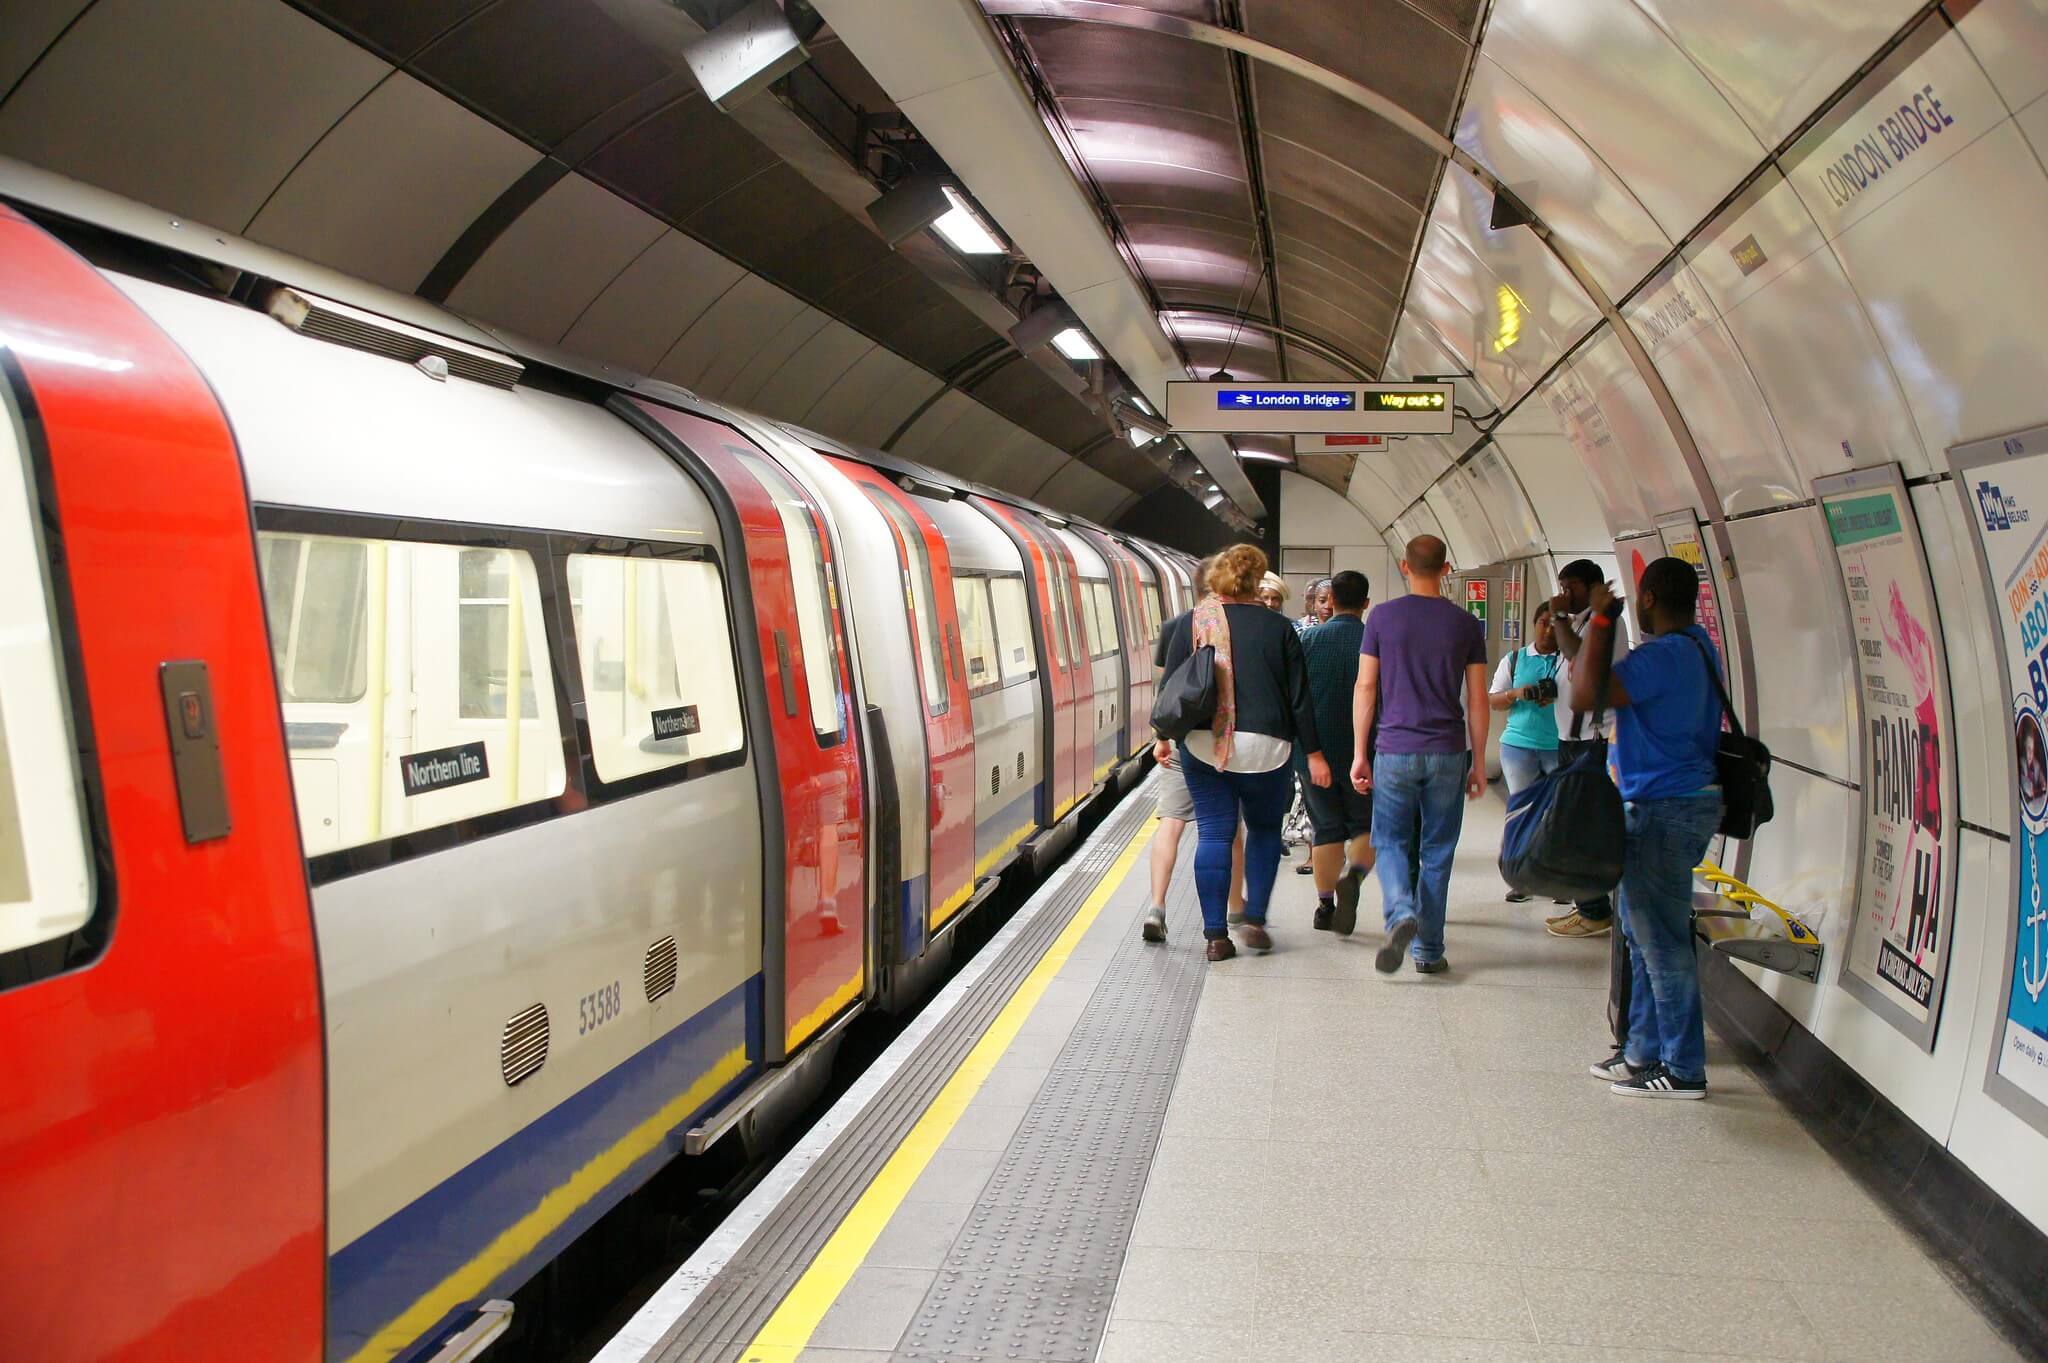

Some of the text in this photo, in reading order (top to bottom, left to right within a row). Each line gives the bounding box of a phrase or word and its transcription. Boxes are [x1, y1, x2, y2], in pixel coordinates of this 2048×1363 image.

[1819, 84, 1954, 208] LONDON BRIDGE
[1256, 394, 1340, 407] London Bridge
[1380, 394, 1430, 408] Way out
[2008, 510, 2030, 522] BELFAST
[2009, 577, 2031, 624] JOIN
[408, 752, 480, 788] Northern line
[1905, 846, 1942, 954] HA
[580, 980, 620, 1036] 53588
[2013, 1036, 2026, 1054] Open
[2025, 1043, 2037, 1063] daily
